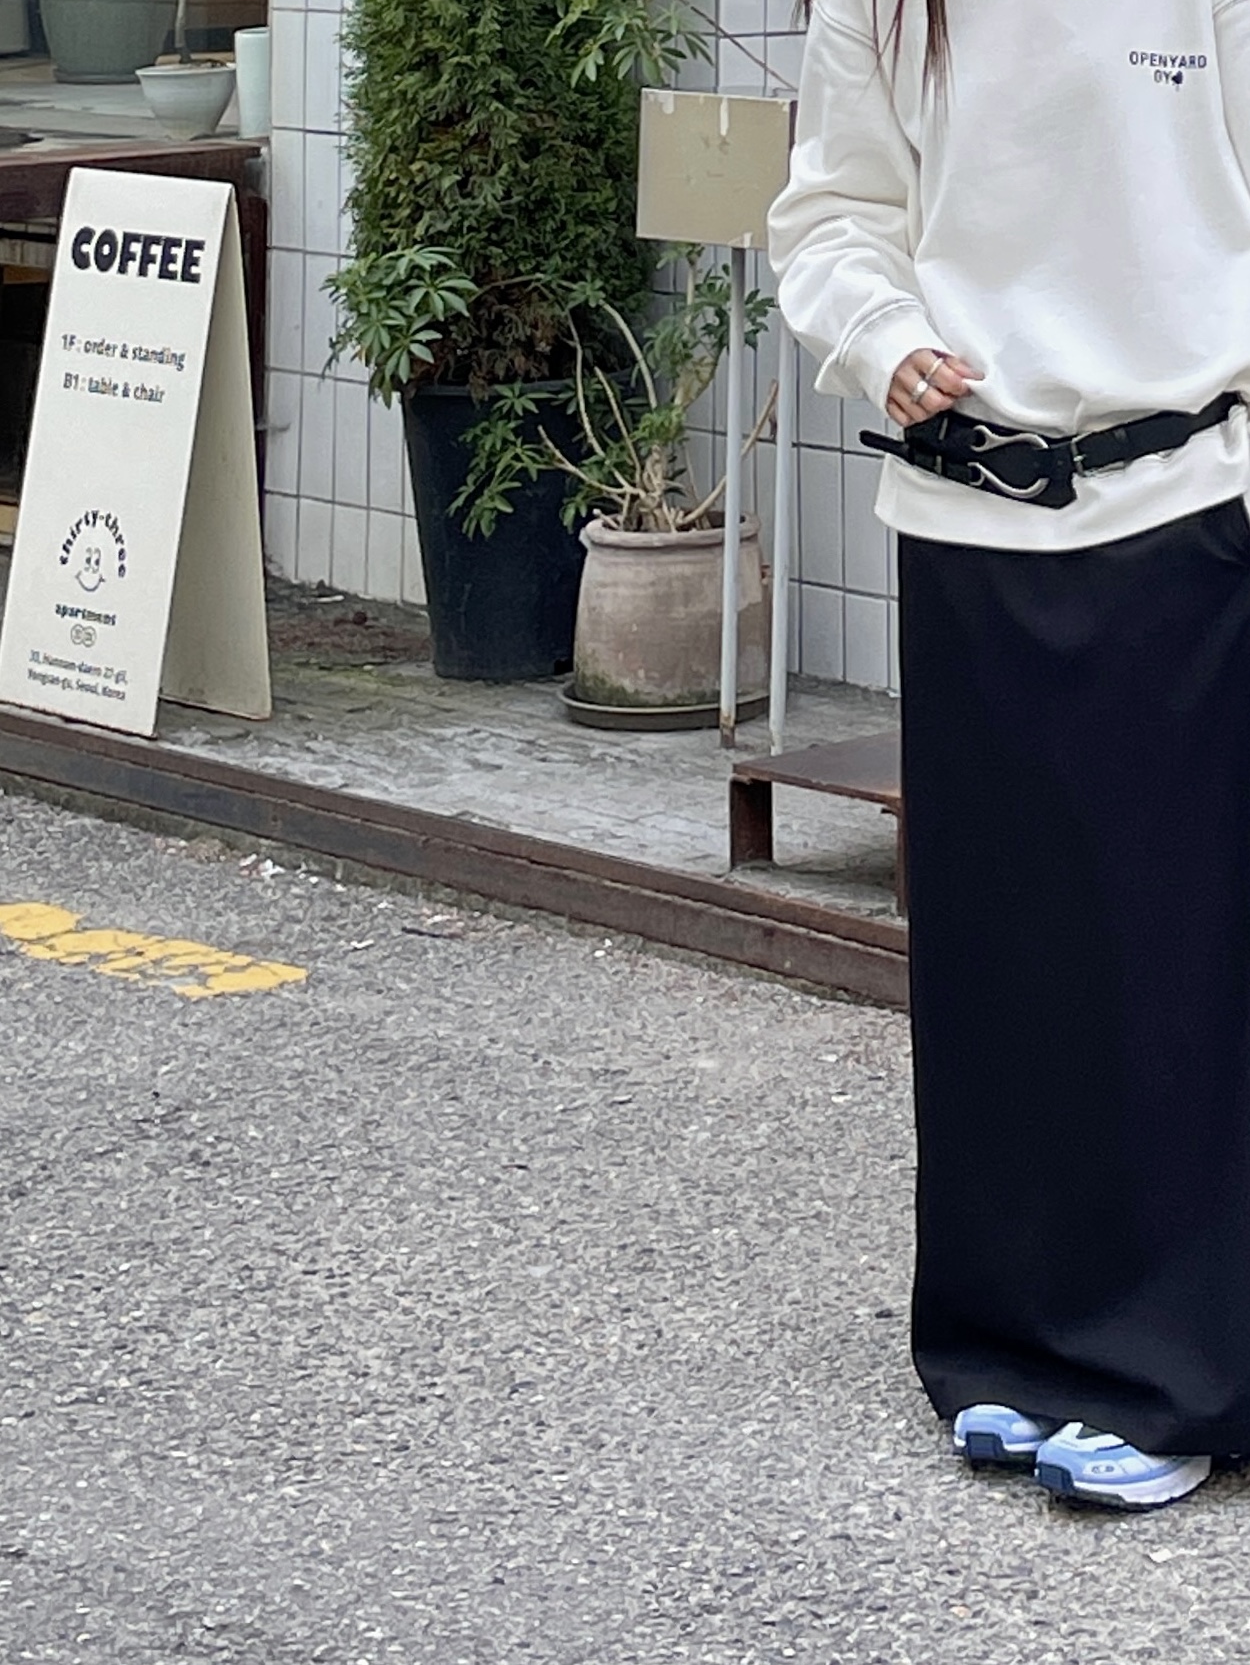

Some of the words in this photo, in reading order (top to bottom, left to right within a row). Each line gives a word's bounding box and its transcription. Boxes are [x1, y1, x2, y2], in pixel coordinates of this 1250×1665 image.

[1129, 51, 1207, 69] OPENYARD
[71, 226, 206, 284] COFFEE
[84, 338, 118, 358] order
[120, 343, 129, 359] &
[132, 346, 186, 372] standing
[88, 377, 118, 397] table
[121, 381, 130, 398] &
[133, 382, 165, 403] chair
